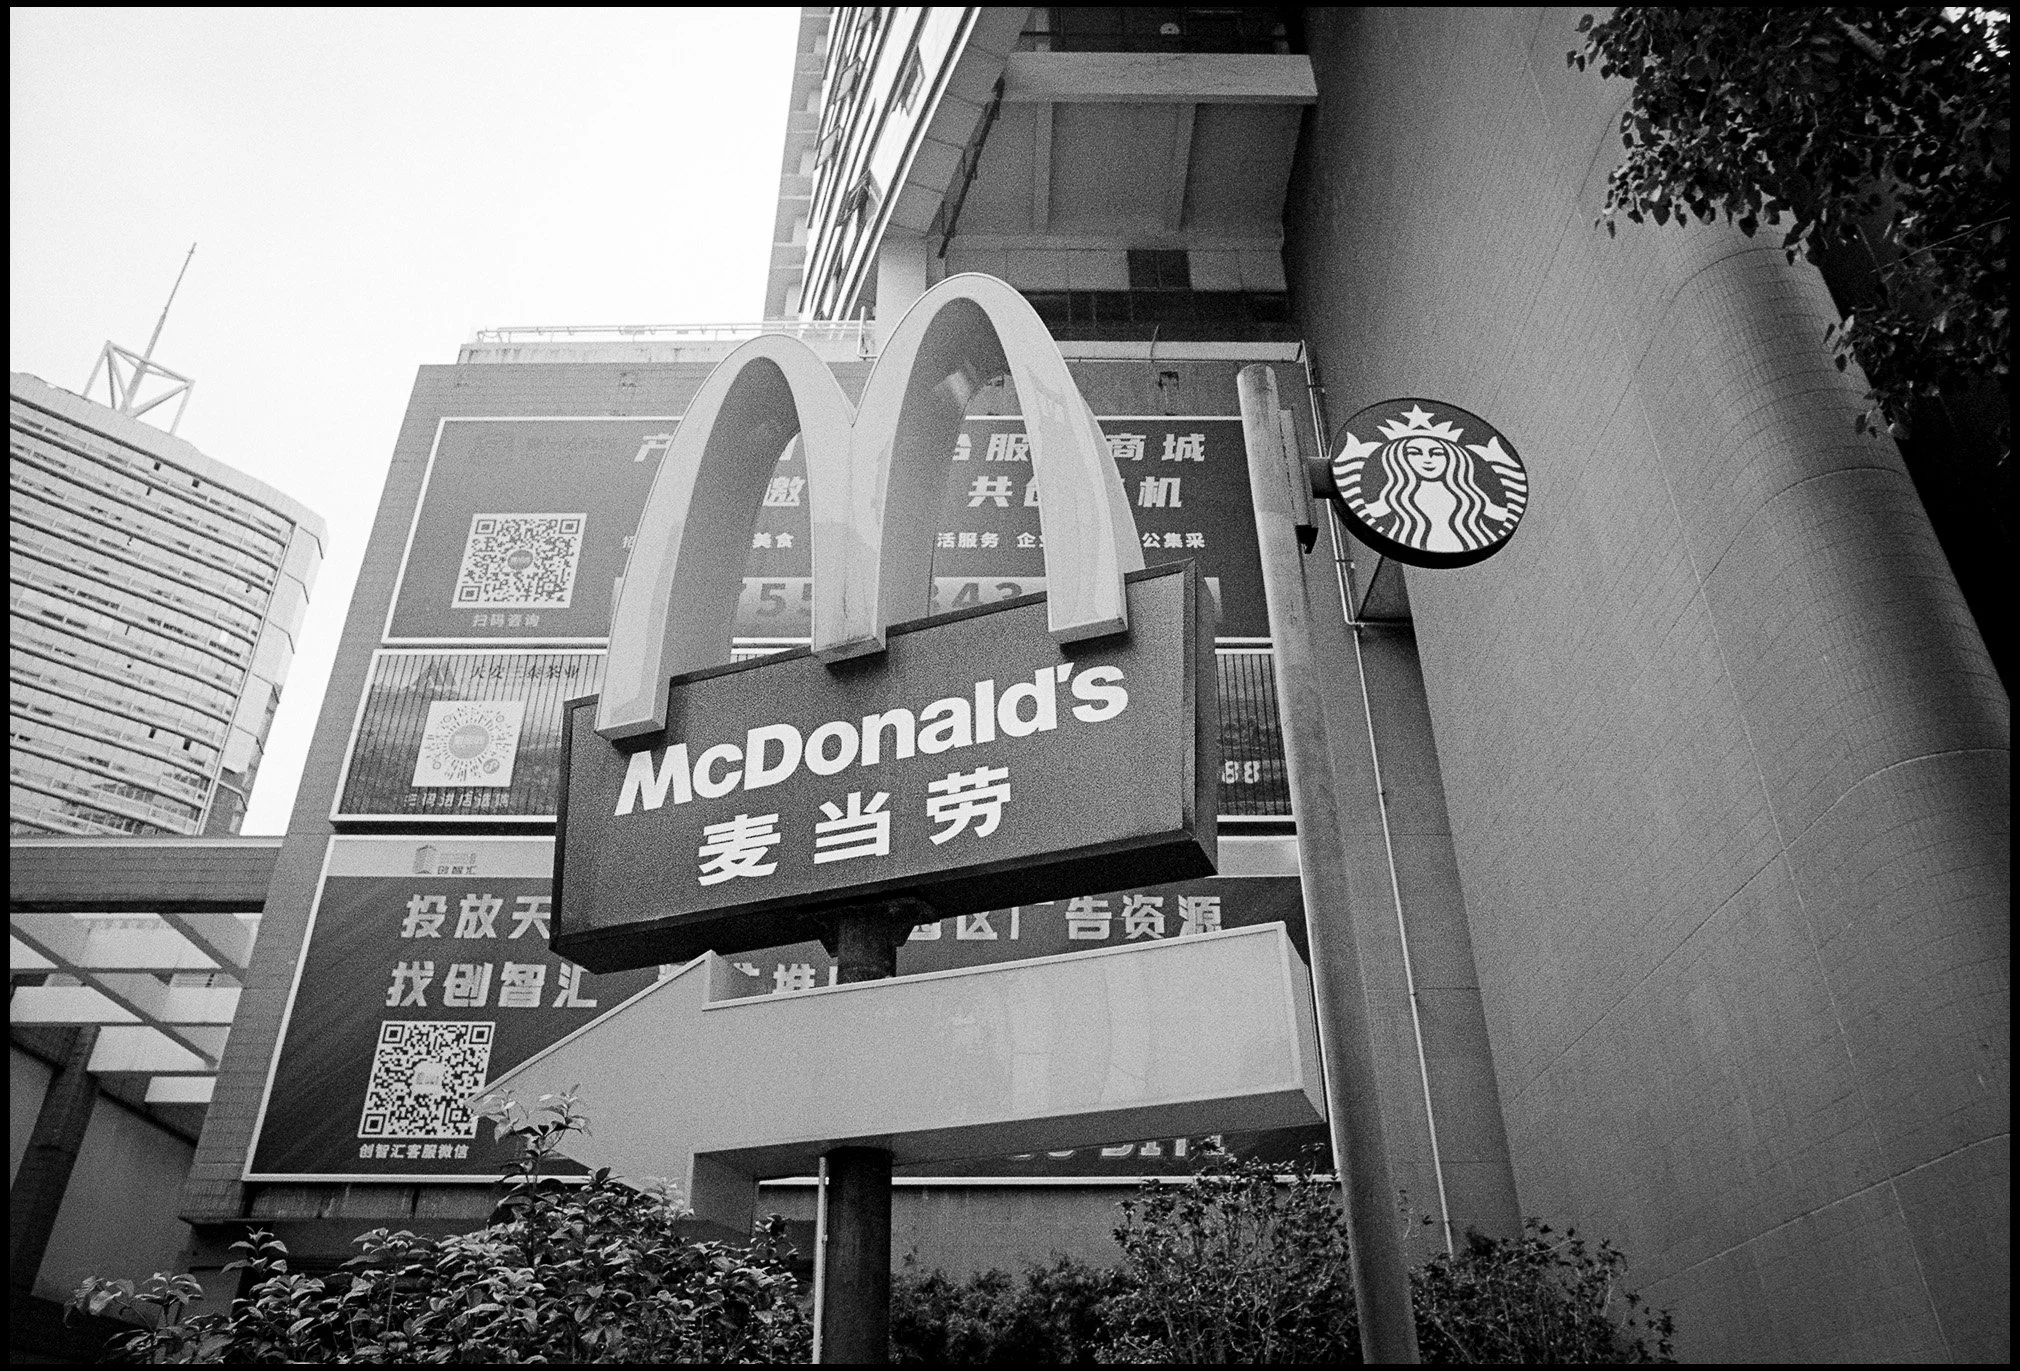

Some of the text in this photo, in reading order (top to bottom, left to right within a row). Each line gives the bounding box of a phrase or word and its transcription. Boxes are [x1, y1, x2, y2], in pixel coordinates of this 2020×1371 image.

[613, 661, 1129, 816] McDonald's
[698, 765, 1012, 887] 麦当劳
[384, 960, 599, 1009] 找创智汇
